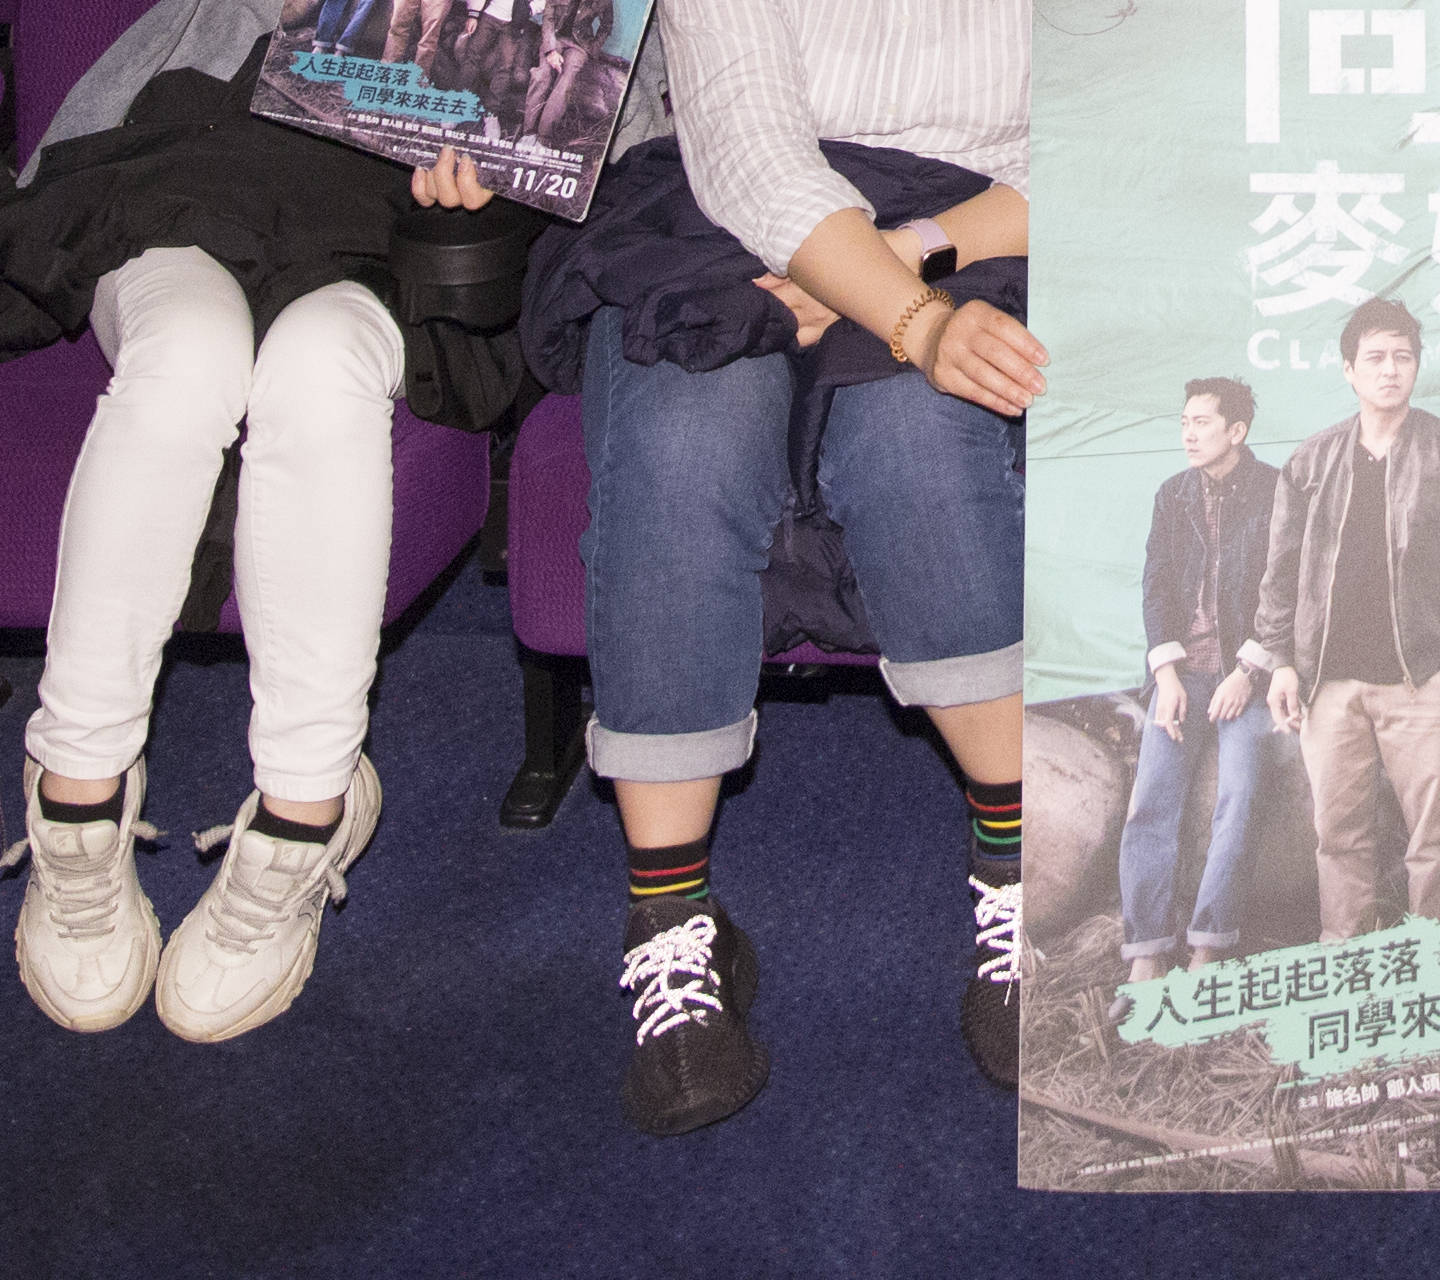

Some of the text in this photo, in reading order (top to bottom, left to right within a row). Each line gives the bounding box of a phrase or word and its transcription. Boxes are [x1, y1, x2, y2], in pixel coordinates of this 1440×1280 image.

[510, 165, 579, 200] 11/20
[1142, 935, 1425, 1034] 人生起起落落
